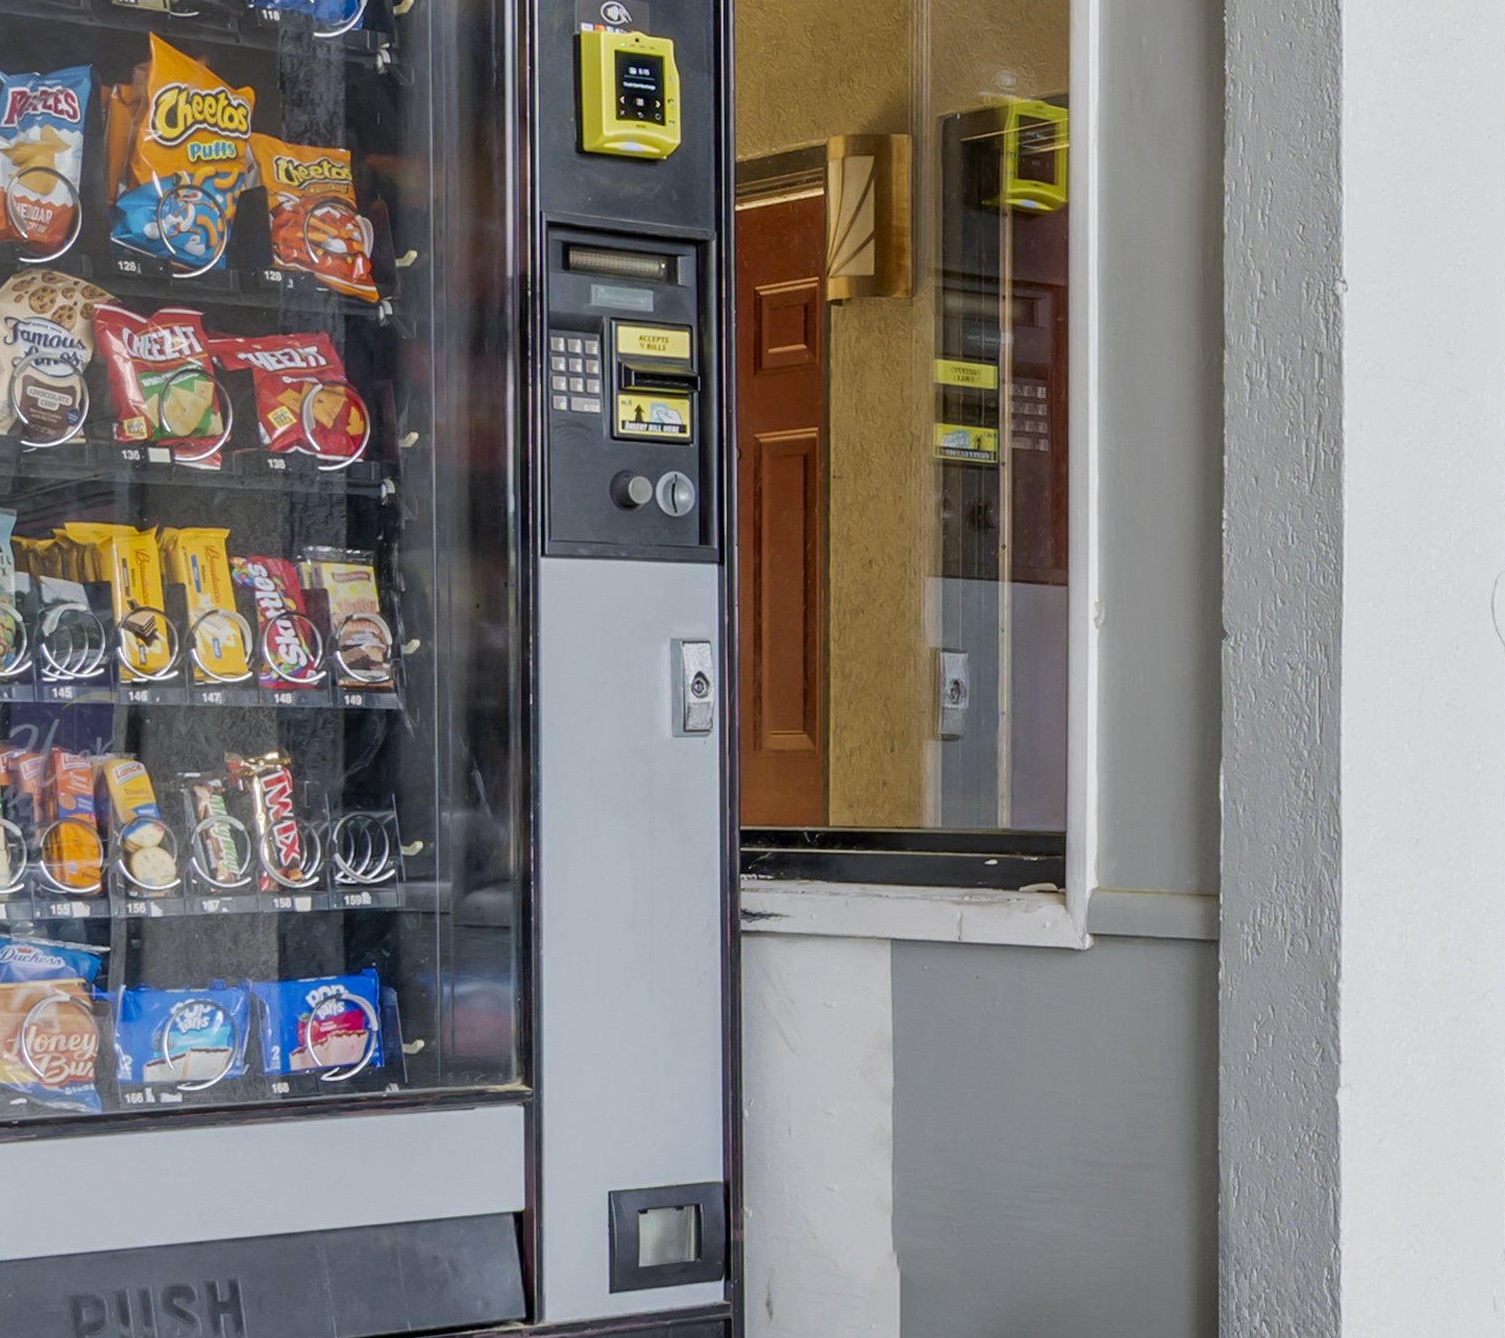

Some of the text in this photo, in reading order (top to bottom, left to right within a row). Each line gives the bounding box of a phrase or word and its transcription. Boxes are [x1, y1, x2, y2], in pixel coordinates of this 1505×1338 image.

[262, 9, 280, 22] 118
[154, 89, 249, 139] Cheetos
[188, 141, 237, 162] Puffs
[275, 158, 352, 187] Cheetos
[15, 204, 53, 225] HEDDAR
[4, 317, 86, 349] Famous
[639, 334, 670, 344] ACCEPTS
[52, 686, 72, 699] 145
[128, 691, 147, 702] 146
[202, 692, 220, 703] 147
[274, 693, 292, 704] 148
[344, 694, 363, 706] 149
[114, 763, 143, 779] Lance
[261, 767, 301, 866] TWIX
[274, 897, 292, 909] 158
[344, 894, 362, 905] 159
[50, 904, 70, 915] 155
[127, 903, 147, 914] 156
[7, 1024, 97, 1059] Honey
[125, 1092, 143, 1104] 166
